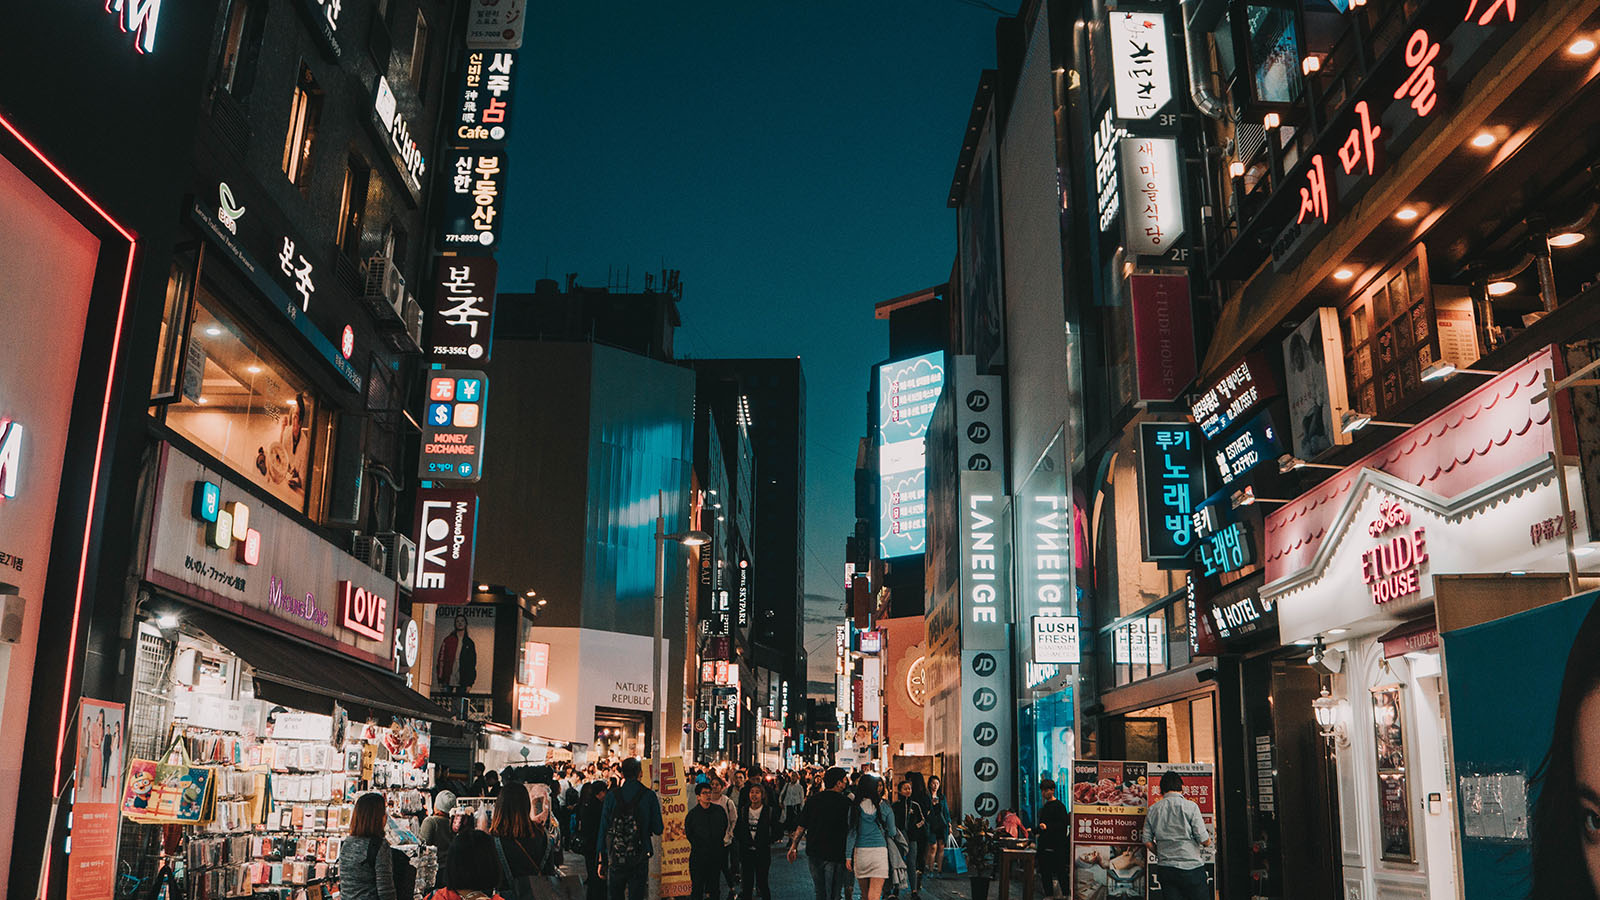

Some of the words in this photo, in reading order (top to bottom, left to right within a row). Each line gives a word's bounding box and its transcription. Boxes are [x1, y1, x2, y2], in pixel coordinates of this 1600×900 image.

[1159, 114, 1176, 126] 3F
[457, 125, 489, 140] Cafe
[392, 112, 425, 190] 신비안
[453, 156, 473, 193] 신한
[471, 156, 500, 231] 부동산
[1138, 141, 1164, 245] 새마을식당
[1171, 249, 1189, 261] 2F
[279, 236, 315, 312] 본죽
[438, 266, 490, 338] 본죽
[1159, 338, 1174, 385] HOUSE
[969, 396, 987, 406] JD
[434, 433, 468, 443] MONEY
[970, 428, 988, 438] JD
[1156, 431, 1190, 450] 루키
[425, 444, 475, 455] EXCHANGE
[1225, 431, 1254, 460] ESTHETIC
[461, 464, 471, 475] 1F
[971, 460, 989, 470] JD
[1162, 453, 1194, 547] 노래방
[1192, 506, 1213, 538] 루키
[416, 501, 452, 589] LOVE
[1200, 522, 1243, 577] 노래방
[970, 495, 996, 623] LANEIGE
[1361, 527, 1429, 585] ETUDE
[1371, 569, 1420, 604] HOUSE
[344, 580, 388, 642] LOVE
[738, 587, 748, 624] SKYPARK
[1223, 597, 1260, 628] HOTEL
[1038, 623, 1075, 633] LUSH
[1038, 635, 1076, 643] FRESH
[1409, 632, 1433, 648] ETUDE
[976, 660, 993, 670] JD
[615, 681, 649, 693] NATURE
[611, 693, 651, 706] REPUBLIC
[977, 694, 994, 704] JD
[977, 729, 995, 739] JD
[978, 764, 996, 775] JD
[979, 799, 996, 810] JD
[1093, 818, 1113, 826] Guest
[1115, 818, 1137, 826] House
